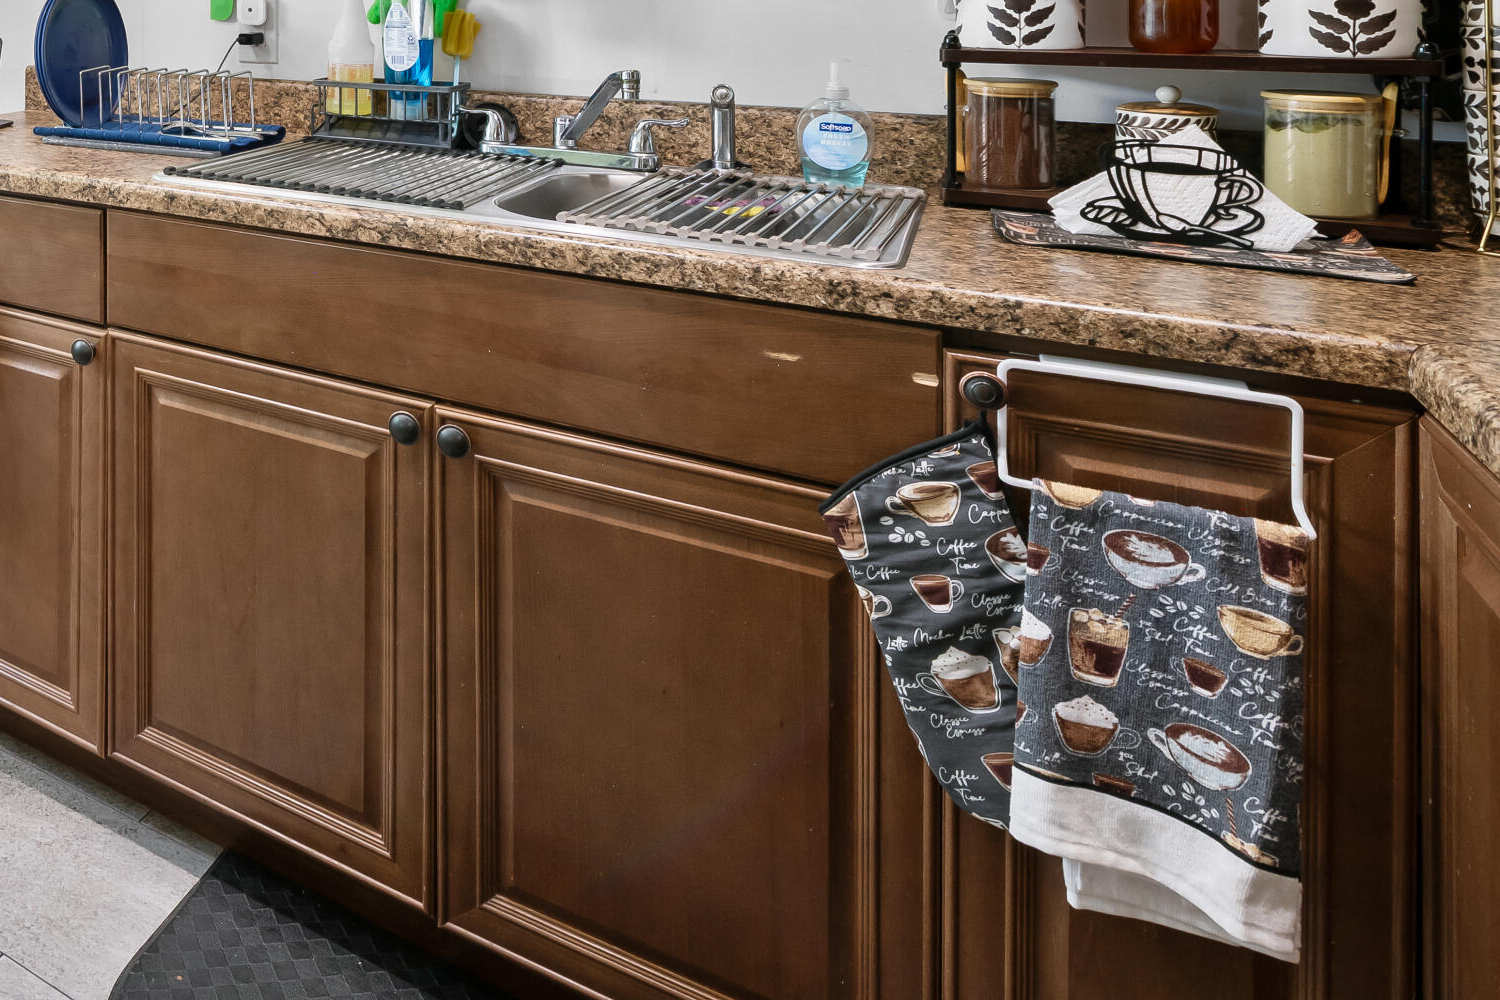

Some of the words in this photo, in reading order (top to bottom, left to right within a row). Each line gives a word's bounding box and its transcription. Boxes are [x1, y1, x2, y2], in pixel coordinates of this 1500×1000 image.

[820, 123, 852, 132] Softsoap
[936, 537, 978, 556] Coffee
[866, 565, 901, 581] Coffee
[948, 557, 981, 575] Time
[971, 592, 1012, 608] Classic
[913, 628, 953, 647] Mocha
[959, 622, 988, 641] Latte
[1173, 616, 1220, 641] Coffee
[930, 713, 970, 729] Classic
[946, 724, 987, 739] Espresso
[938, 767, 980, 784] Coffee
[955, 787, 986, 806] Time
